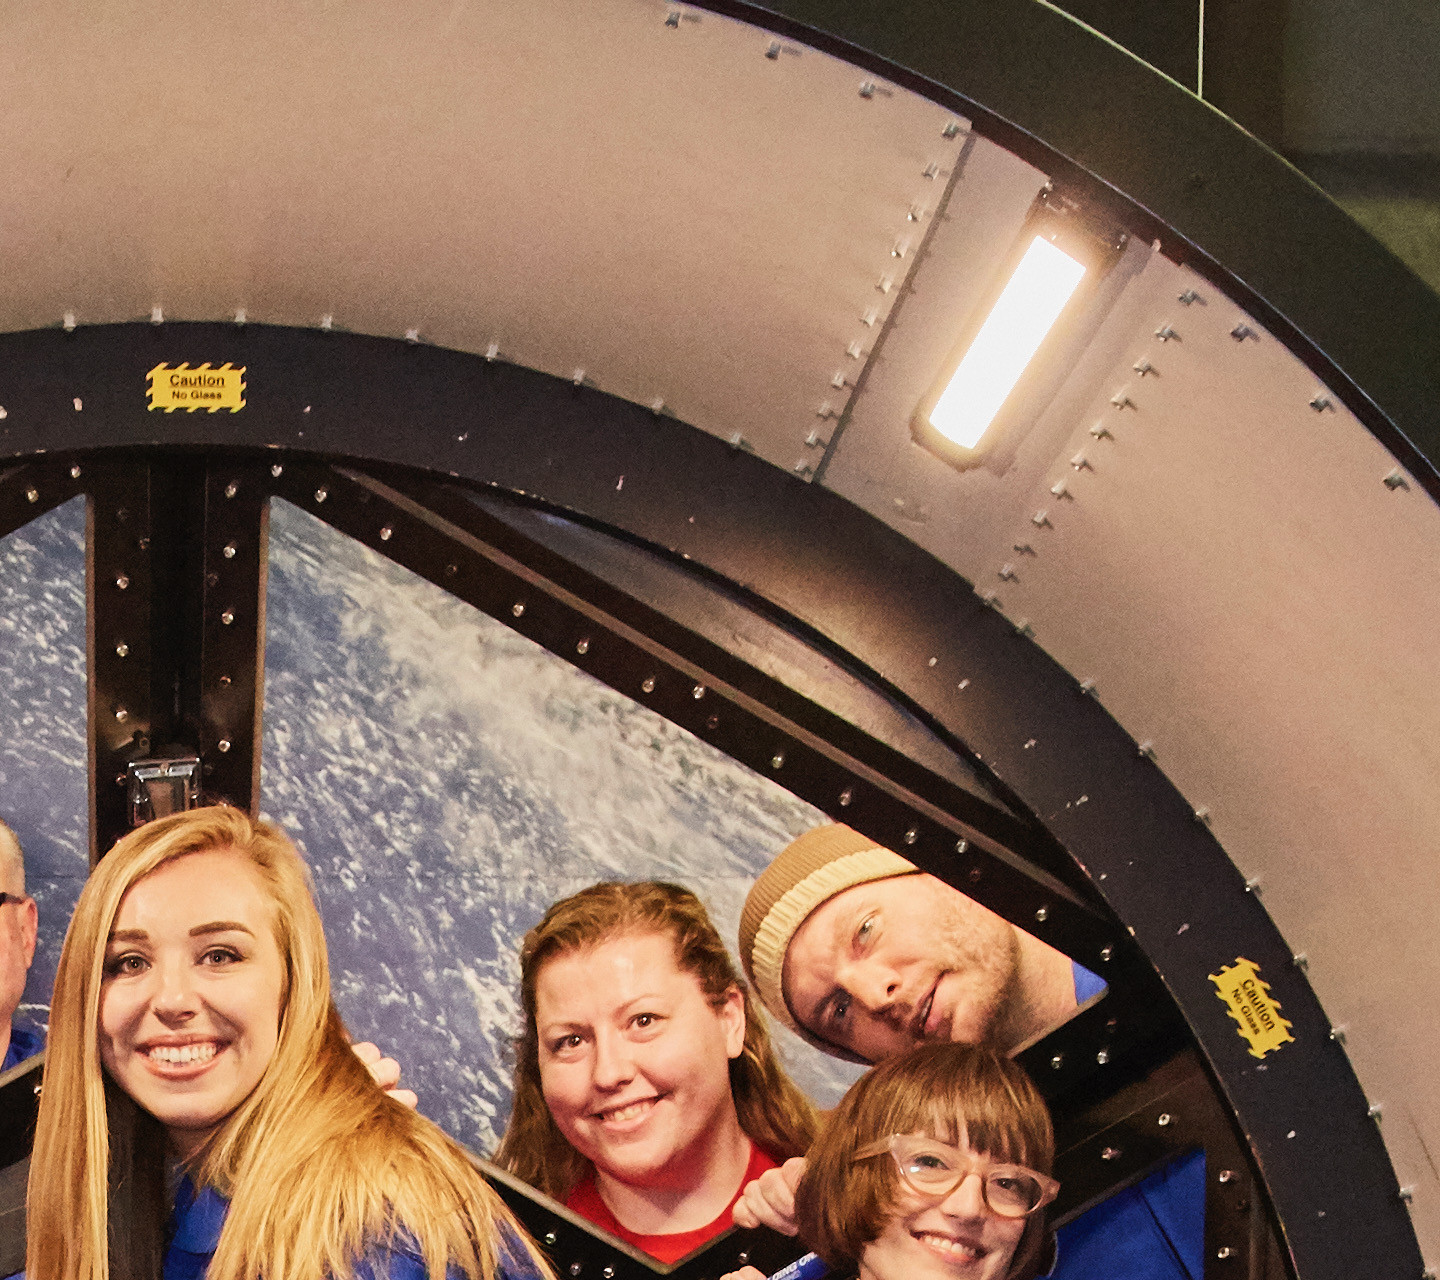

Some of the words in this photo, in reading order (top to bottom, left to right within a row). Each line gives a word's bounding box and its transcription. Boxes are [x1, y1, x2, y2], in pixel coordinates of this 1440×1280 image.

[170, 374, 225, 387] Caution
[172, 391, 187, 400] No
[190, 390, 222, 400] Glass
[1232, 988, 1242, 1004] No
[1240, 1005, 1261, 1035] Glass
[1242, 979, 1276, 1031] Caution
